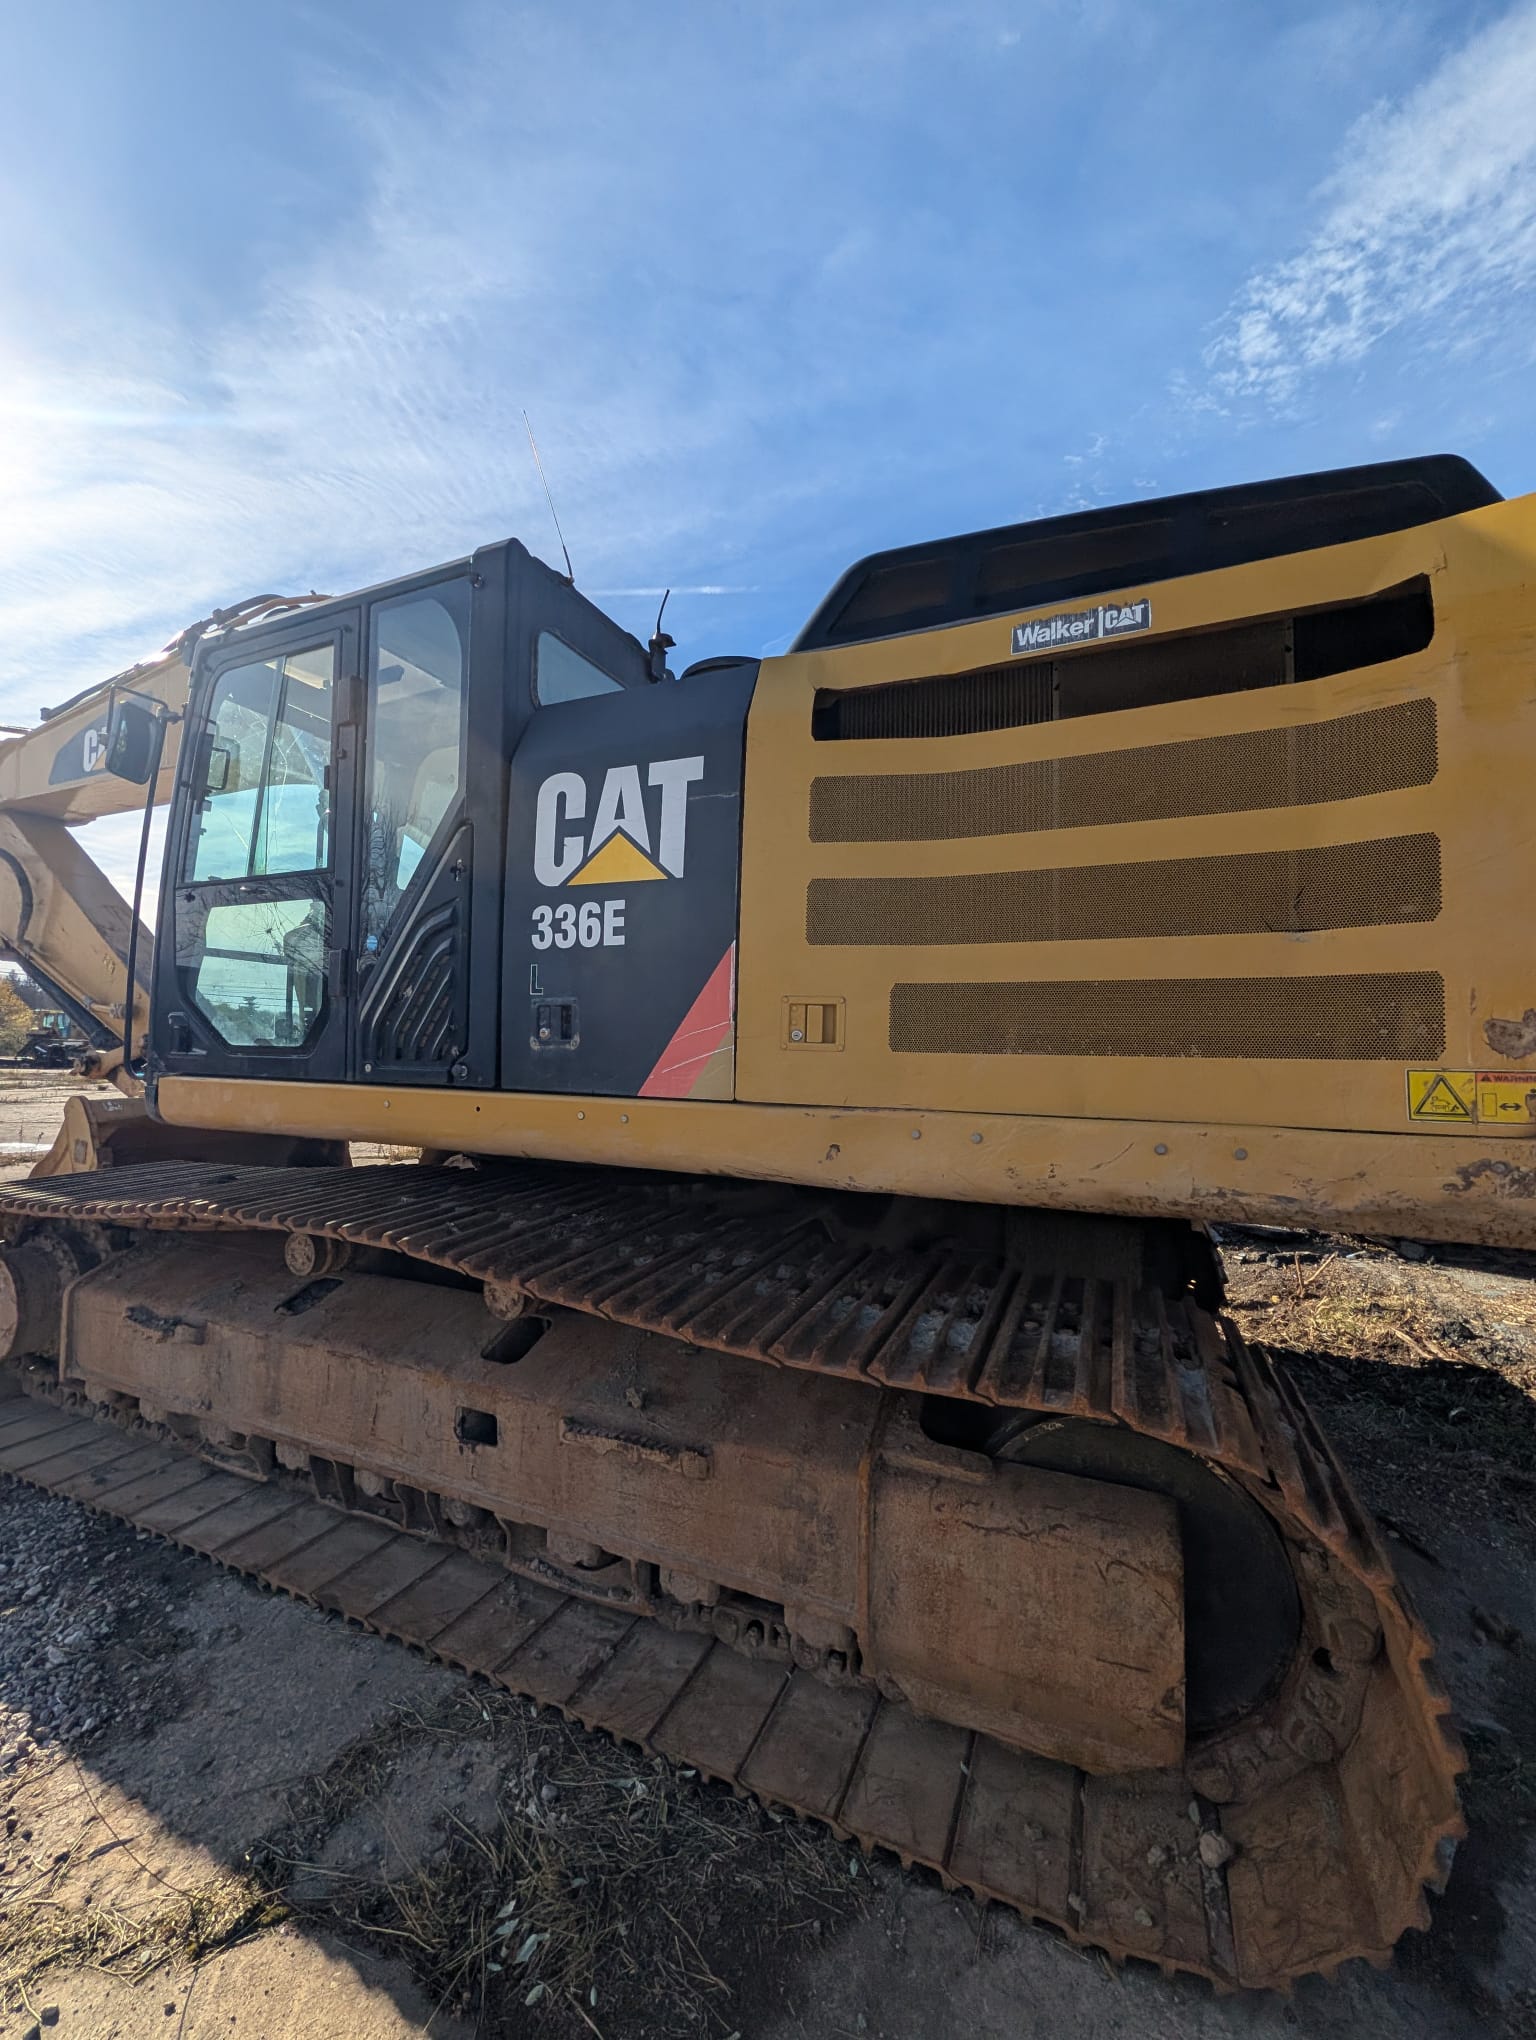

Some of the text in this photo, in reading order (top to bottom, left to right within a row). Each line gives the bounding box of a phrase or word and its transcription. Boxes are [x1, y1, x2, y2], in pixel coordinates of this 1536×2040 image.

[1016, 603, 1145, 646] Walker CAT
[533, 755, 705, 887] CAT
[531, 899, 626, 950] 336E
[529, 963, 544, 995] L
